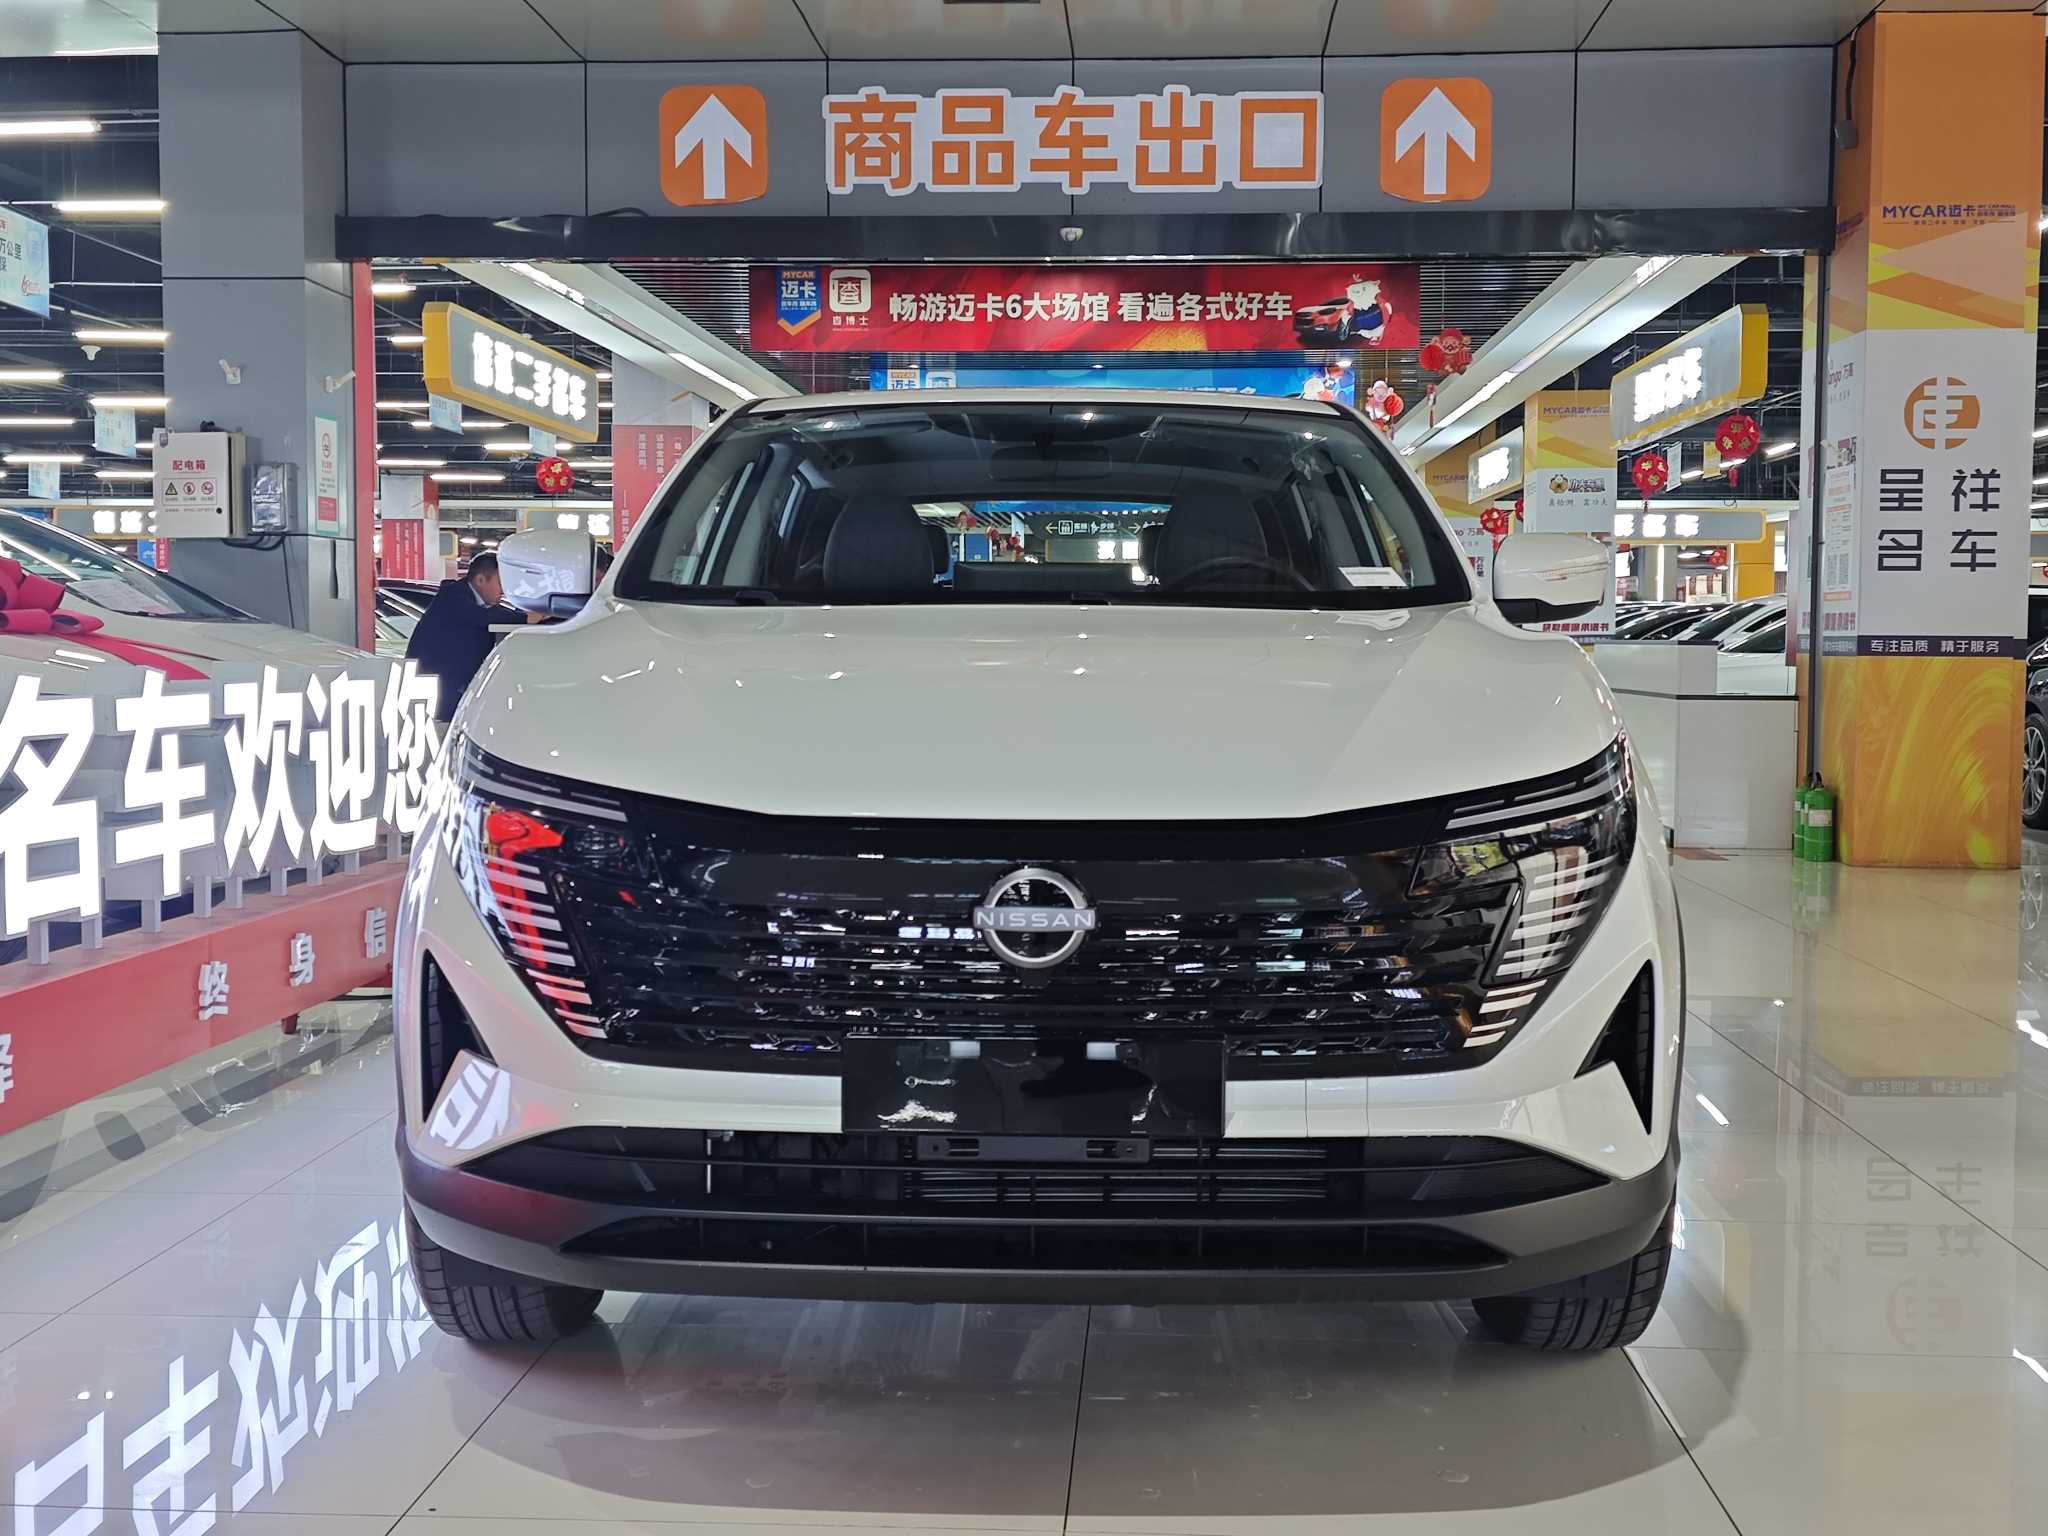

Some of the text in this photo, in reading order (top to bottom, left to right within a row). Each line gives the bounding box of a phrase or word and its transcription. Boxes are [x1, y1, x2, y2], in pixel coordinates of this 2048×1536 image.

[828, 91, 1318, 189] 商品车出口
[782, 271, 816, 279] MYCAR
[781, 281, 816, 298] 迈卡
[889, 292, 1293, 322] 畅游迈卡6大场馆 看遍各式好车
[172, 459, 207, 471] 配电箱
[1879, 468, 2001, 512] 呈祥
[1878, 529, 1998, 572] 名车
[1871, 640, 1929, 653] 专注品质
[1940, 640, 2000, 653] 精于服务
[976, 910, 1094, 929] NISSAN
